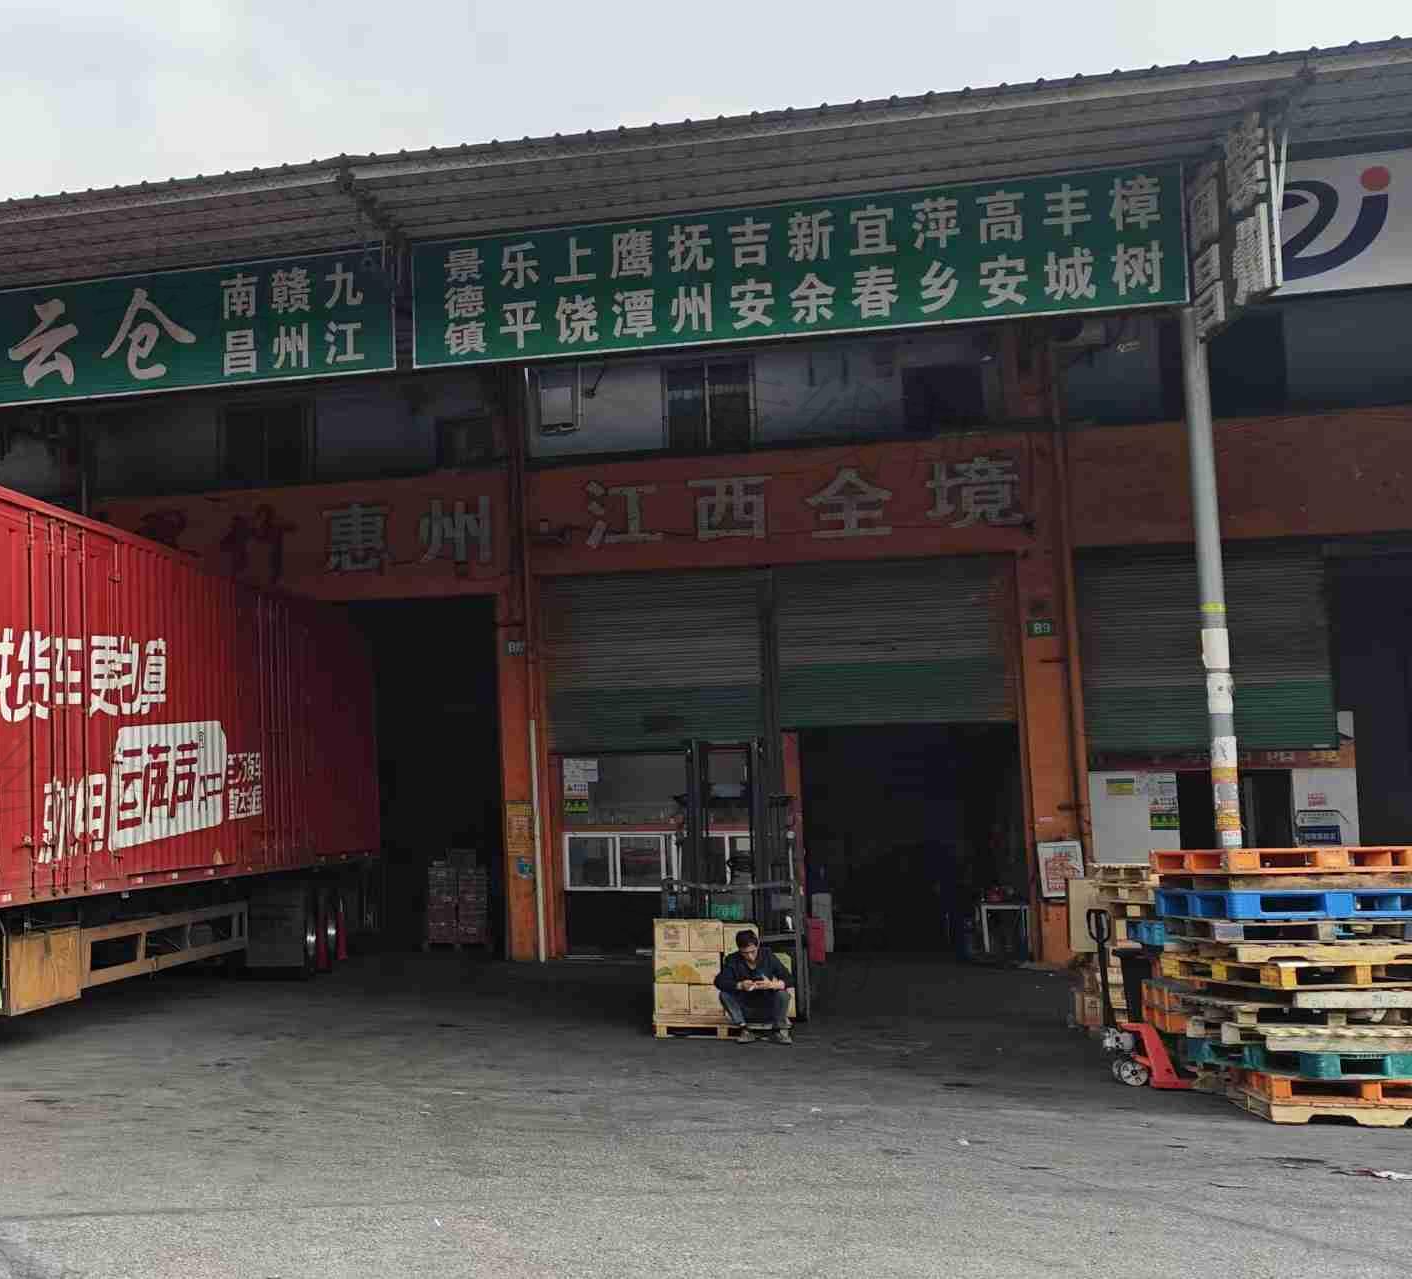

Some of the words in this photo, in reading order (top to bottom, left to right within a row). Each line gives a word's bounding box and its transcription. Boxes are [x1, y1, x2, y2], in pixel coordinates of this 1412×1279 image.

[443, 248, 486, 357] 景德镇
[498, 240, 541, 349] 乐平
[554, 236, 599, 344] 上饶
[610, 230, 655, 339] 鹰潭
[668, 224, 715, 334] 抚州
[727, 217, 776, 330] 吉安
[787, 212, 836, 324] 新余
[848, 205, 899, 319] 宜春
[910, 199, 960, 314] 萍乡
[976, 190, 1029, 308] 高安
[1041, 183, 1096, 301] 丰城
[1107, 176, 1164, 297] 樟树
[221, 273, 258, 376] 南昌
[271, 269, 312, 369] 赣州
[325, 263, 364, 363] 九江
[324, 496, 493, 576] 惠州
[587, 455, 1026, 549] 江西全境
